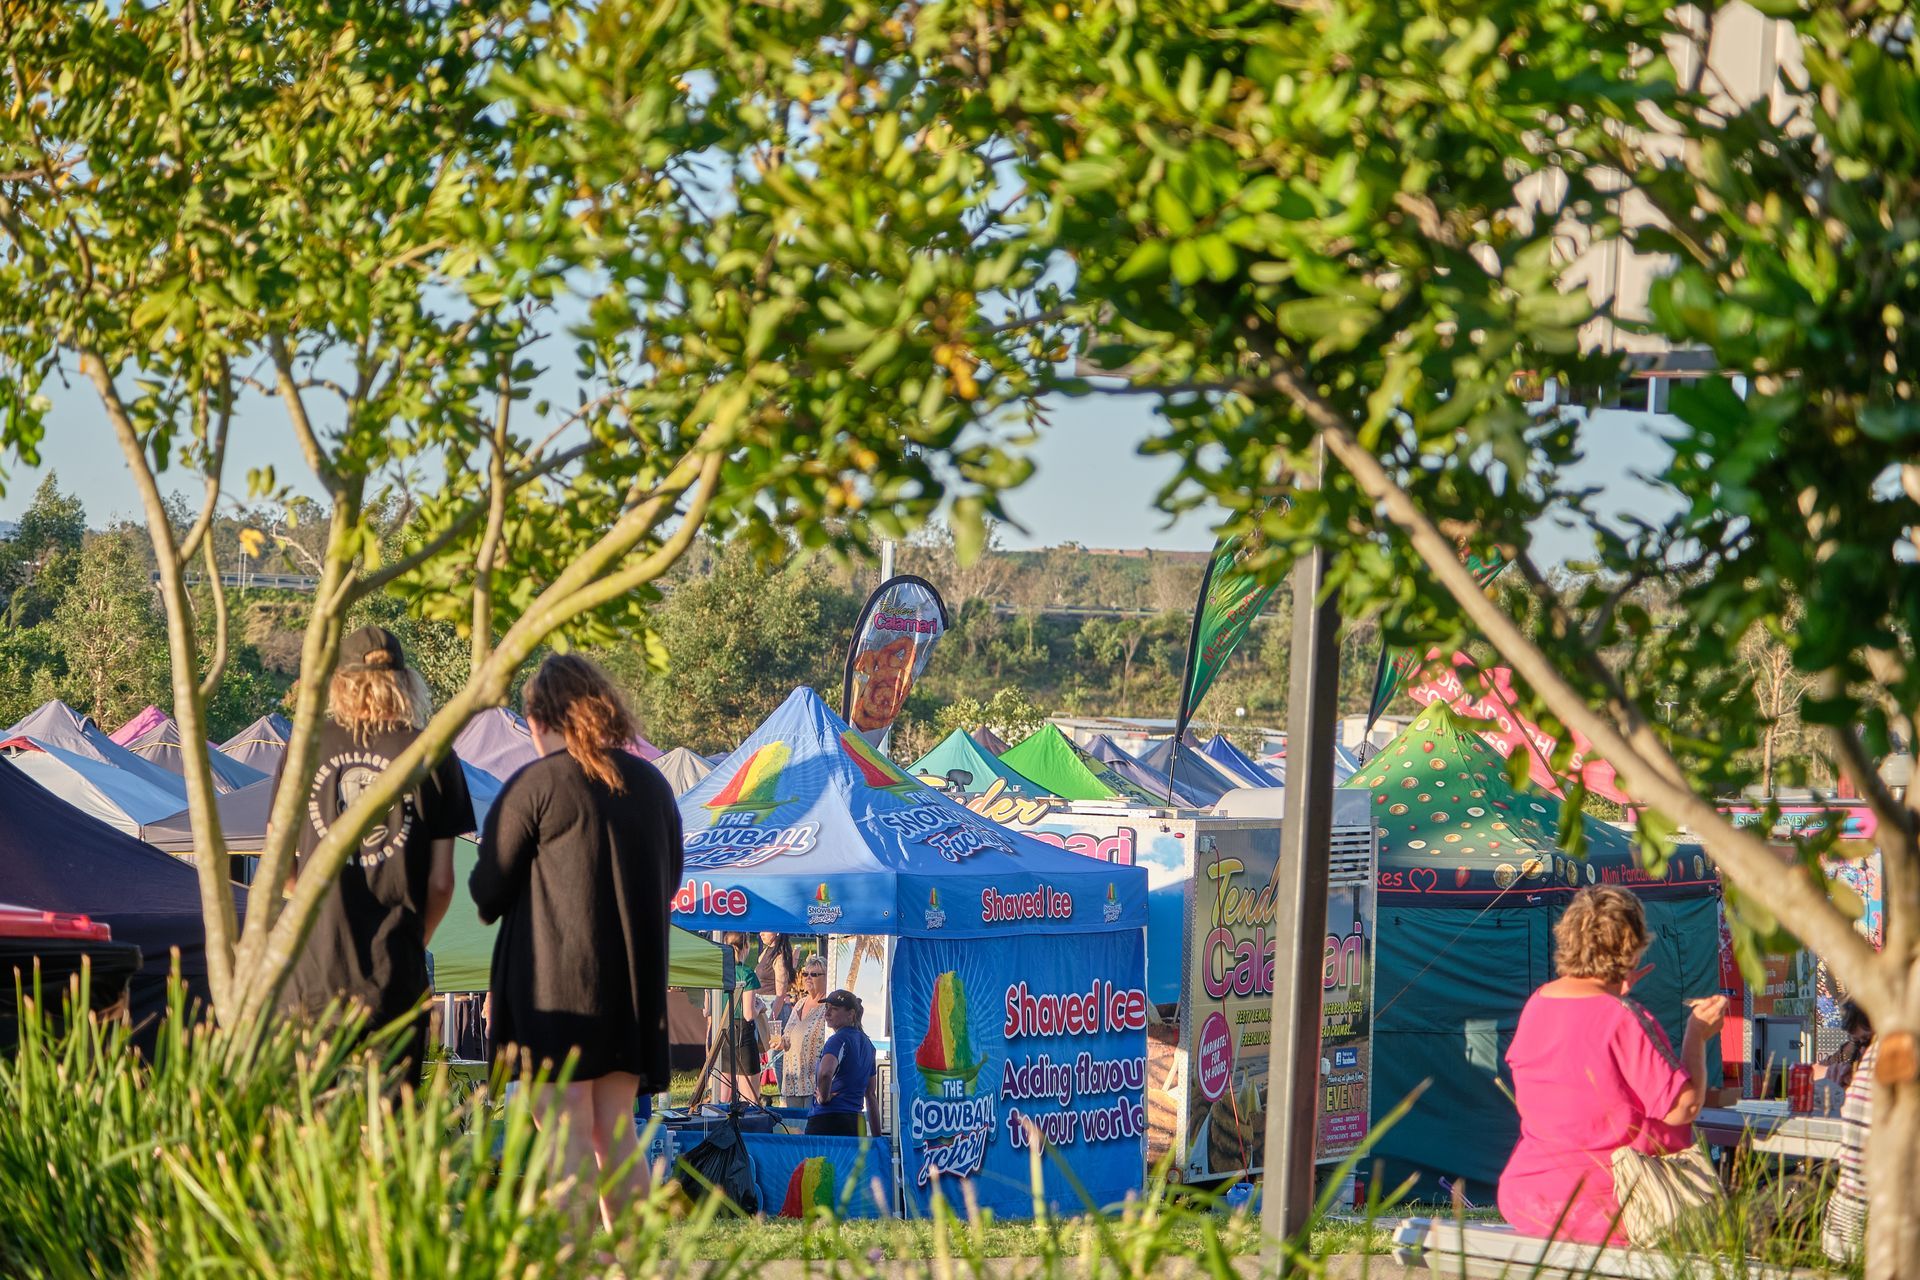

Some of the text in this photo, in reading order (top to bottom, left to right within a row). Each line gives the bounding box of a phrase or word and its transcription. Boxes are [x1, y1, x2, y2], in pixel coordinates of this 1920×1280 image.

[874, 612, 938, 634] Calamari
[1201, 627, 1232, 667] Mini
[1436, 668, 1513, 734] ORNADO
[1525, 727, 1583, 770] CHIS
[312, 751, 390, 790] THE VILLAGE
[719, 812, 756, 827] THE
[683, 824, 814, 851] OWBALL
[360, 845, 394, 867] GOOD
[684, 847, 786, 869] ctory
[1601, 865, 1620, 884] Mini
[702, 881, 748, 916] Ice
[982, 884, 1044, 922] Shaved
[1047, 885, 1072, 918] Ice
[1207, 857, 1281, 929] Tend
[808, 906, 842, 916] SNOWBALL
[1203, 921, 1362, 998] Calaari
[1004, 979, 1146, 1039] Shaved Ice
[1211, 1050, 1220, 1065] FOR
[943, 1080, 963, 1098] THE
[1001, 1052, 1146, 1106] Adding flavou
[911, 1092, 996, 1139] SOWBALL
[1326, 1084, 1363, 1112] EVENT
